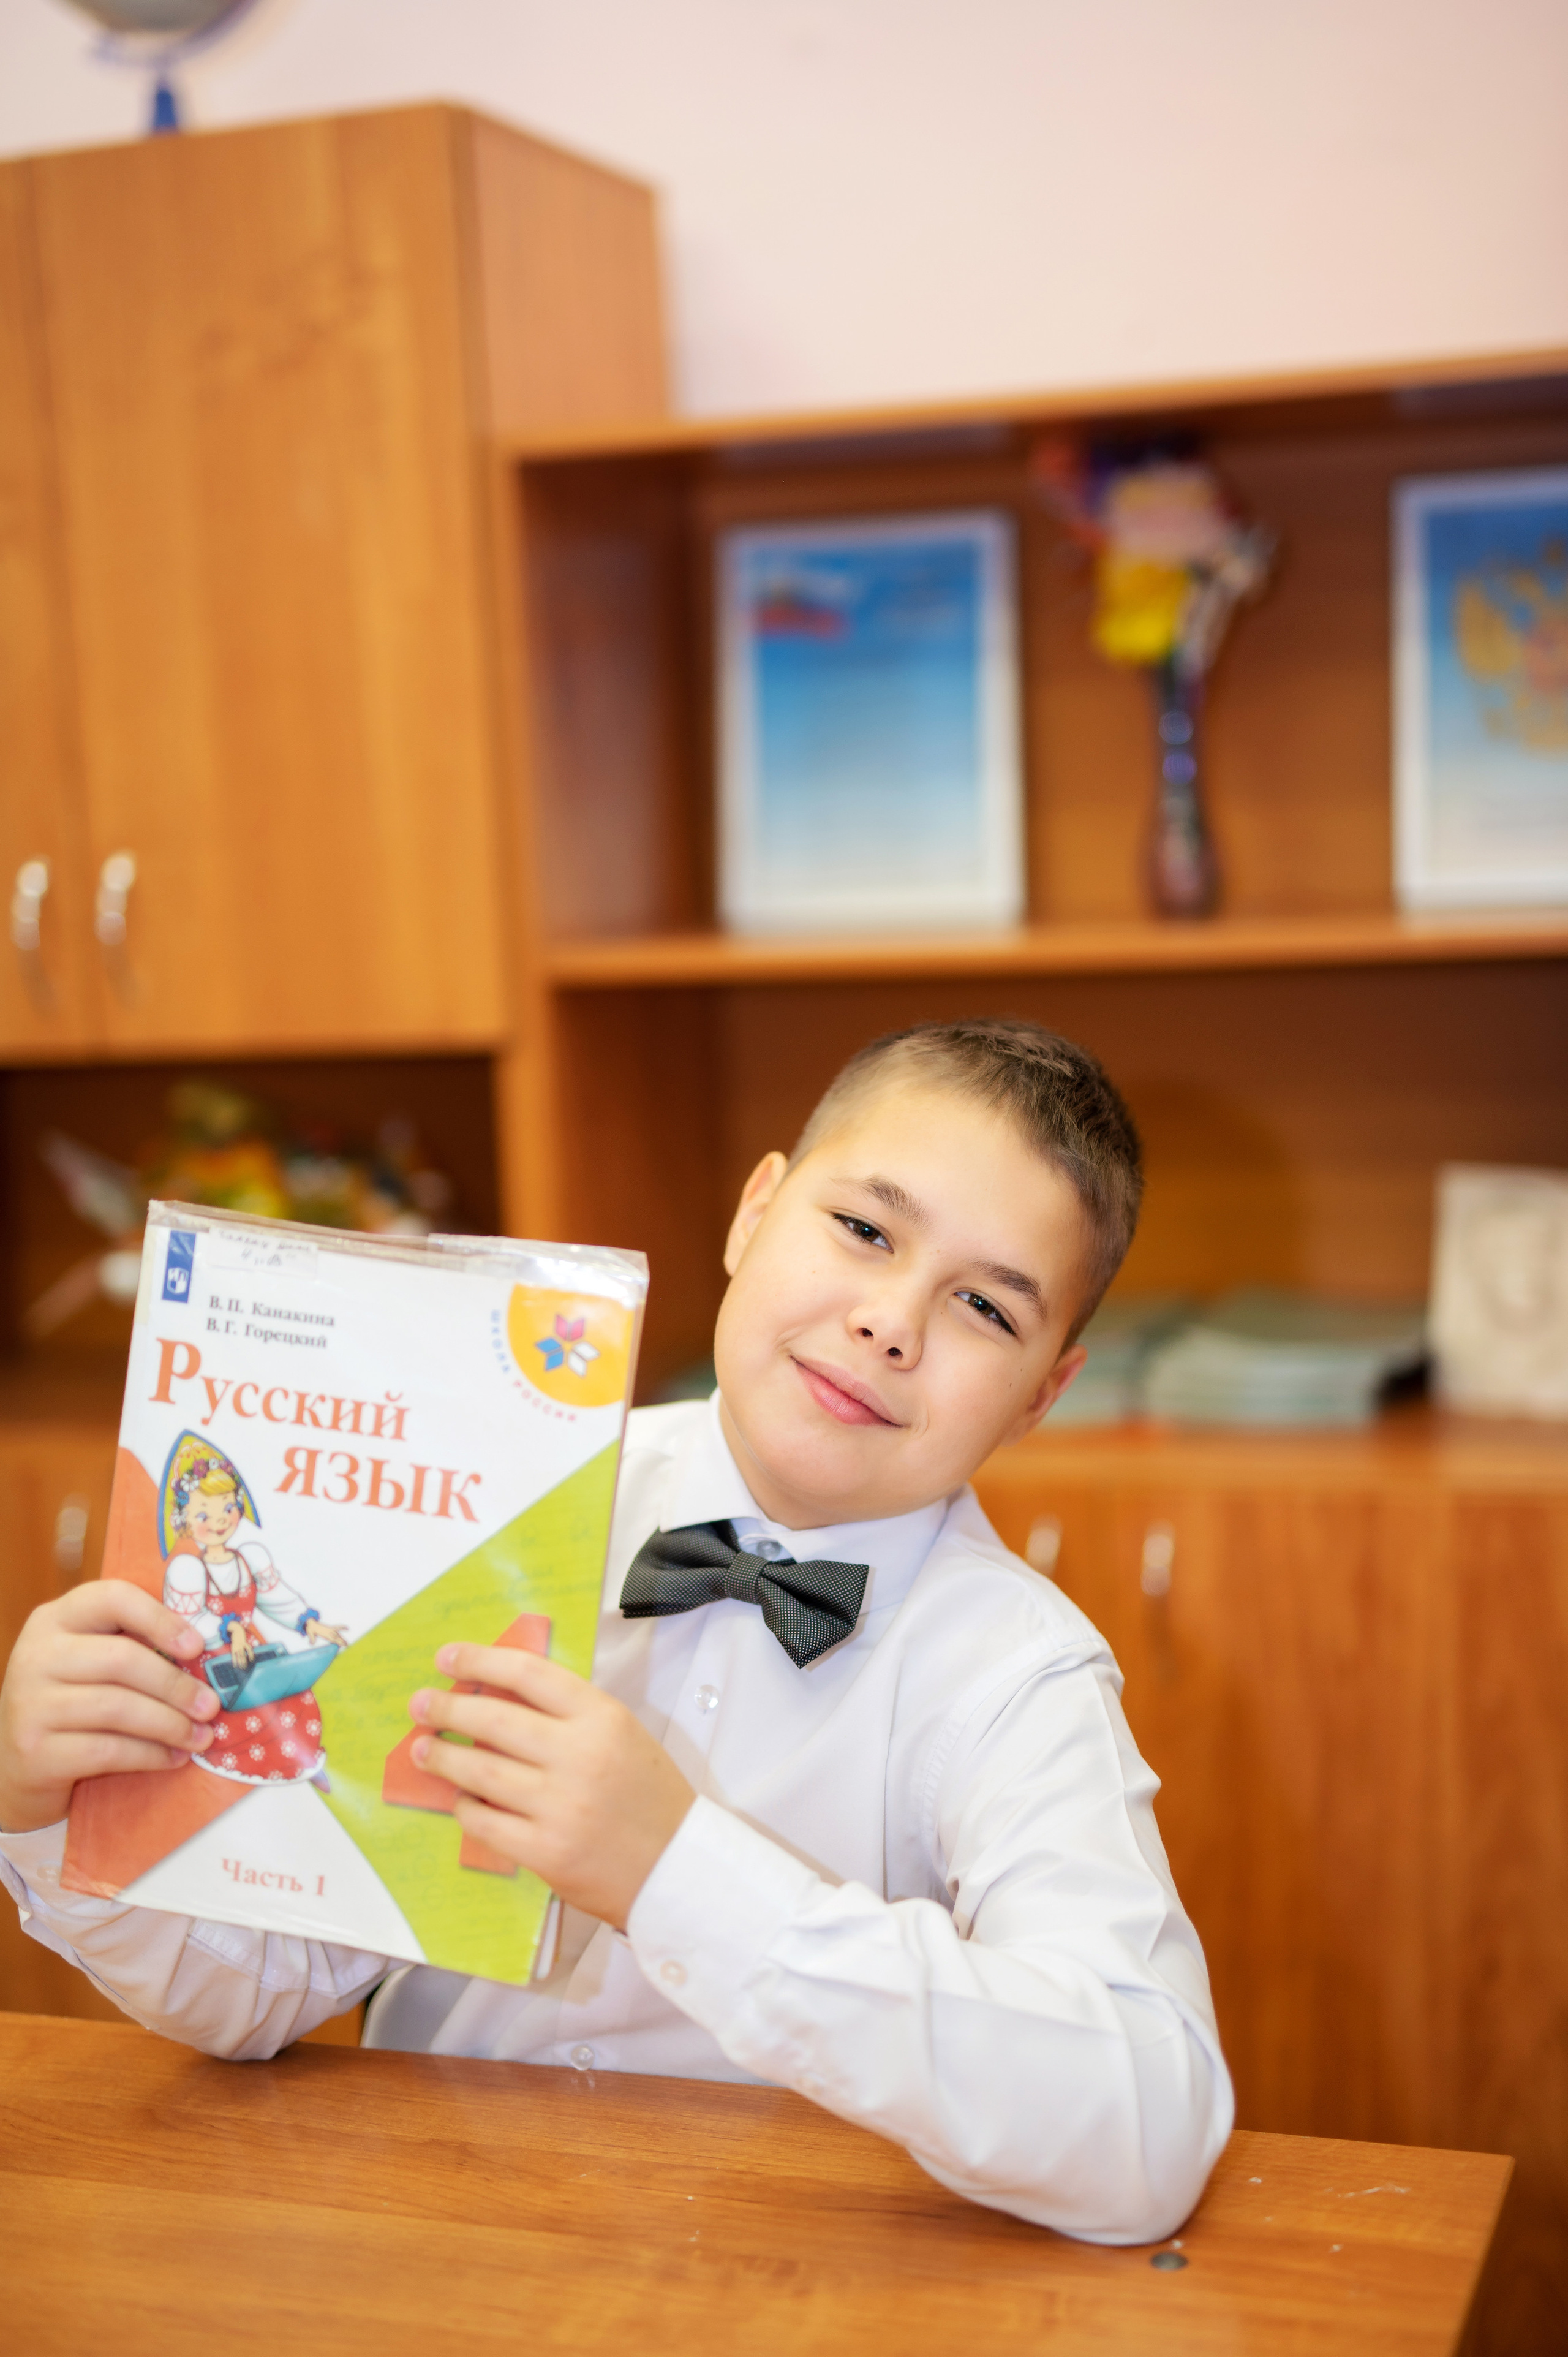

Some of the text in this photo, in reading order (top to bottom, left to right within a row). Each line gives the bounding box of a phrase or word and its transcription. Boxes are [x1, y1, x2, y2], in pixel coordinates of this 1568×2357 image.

[209, 1295, 336, 1327] В. П. Канакина
[206, 1317, 327, 1348] В. Г. Горецкий
[490, 1309, 577, 1423] ШКОЛА РОССИИ
[148, 1337, 410, 1442] Русский
[222, 1858, 325, 1897] Часть 1
